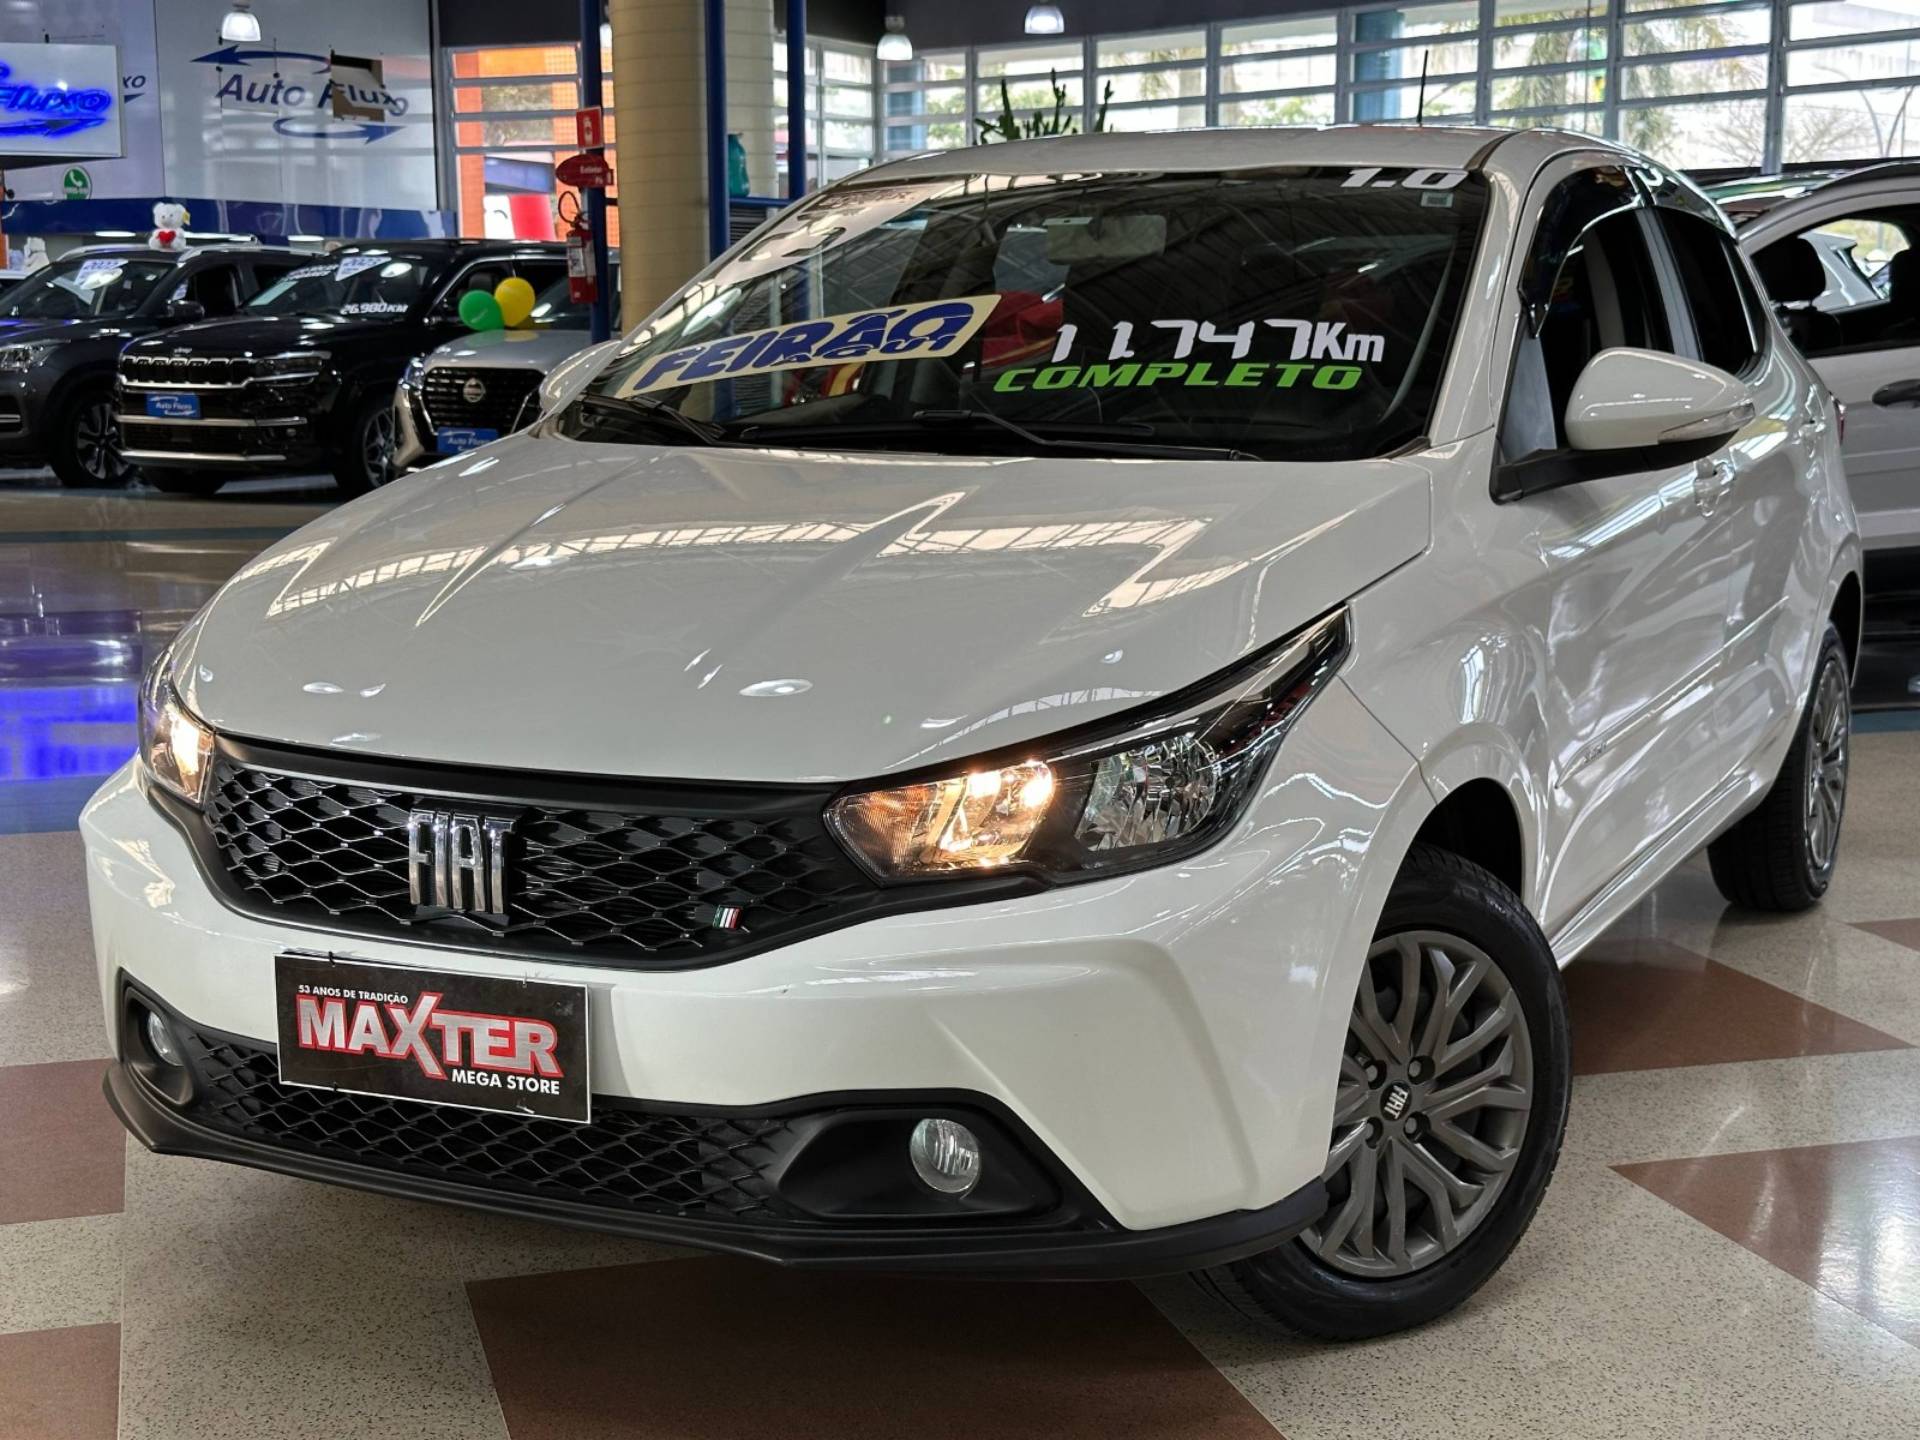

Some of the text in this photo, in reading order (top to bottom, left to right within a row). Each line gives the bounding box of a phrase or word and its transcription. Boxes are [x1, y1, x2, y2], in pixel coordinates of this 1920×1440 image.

[215, 74, 305, 106] Auto
[1340, 167, 1469, 190] 1.0
[993, 362, 1362, 392] COMPLETO
[408, 808, 515, 914] FIAT
[298, 984, 409, 1006] 53 ANOS DE TRADIÇÃO
[296, 992, 564, 1080] MAXTER
[451, 1068, 560, 1095] MEGA STORE
[1384, 1085, 1409, 1119] FIAT
